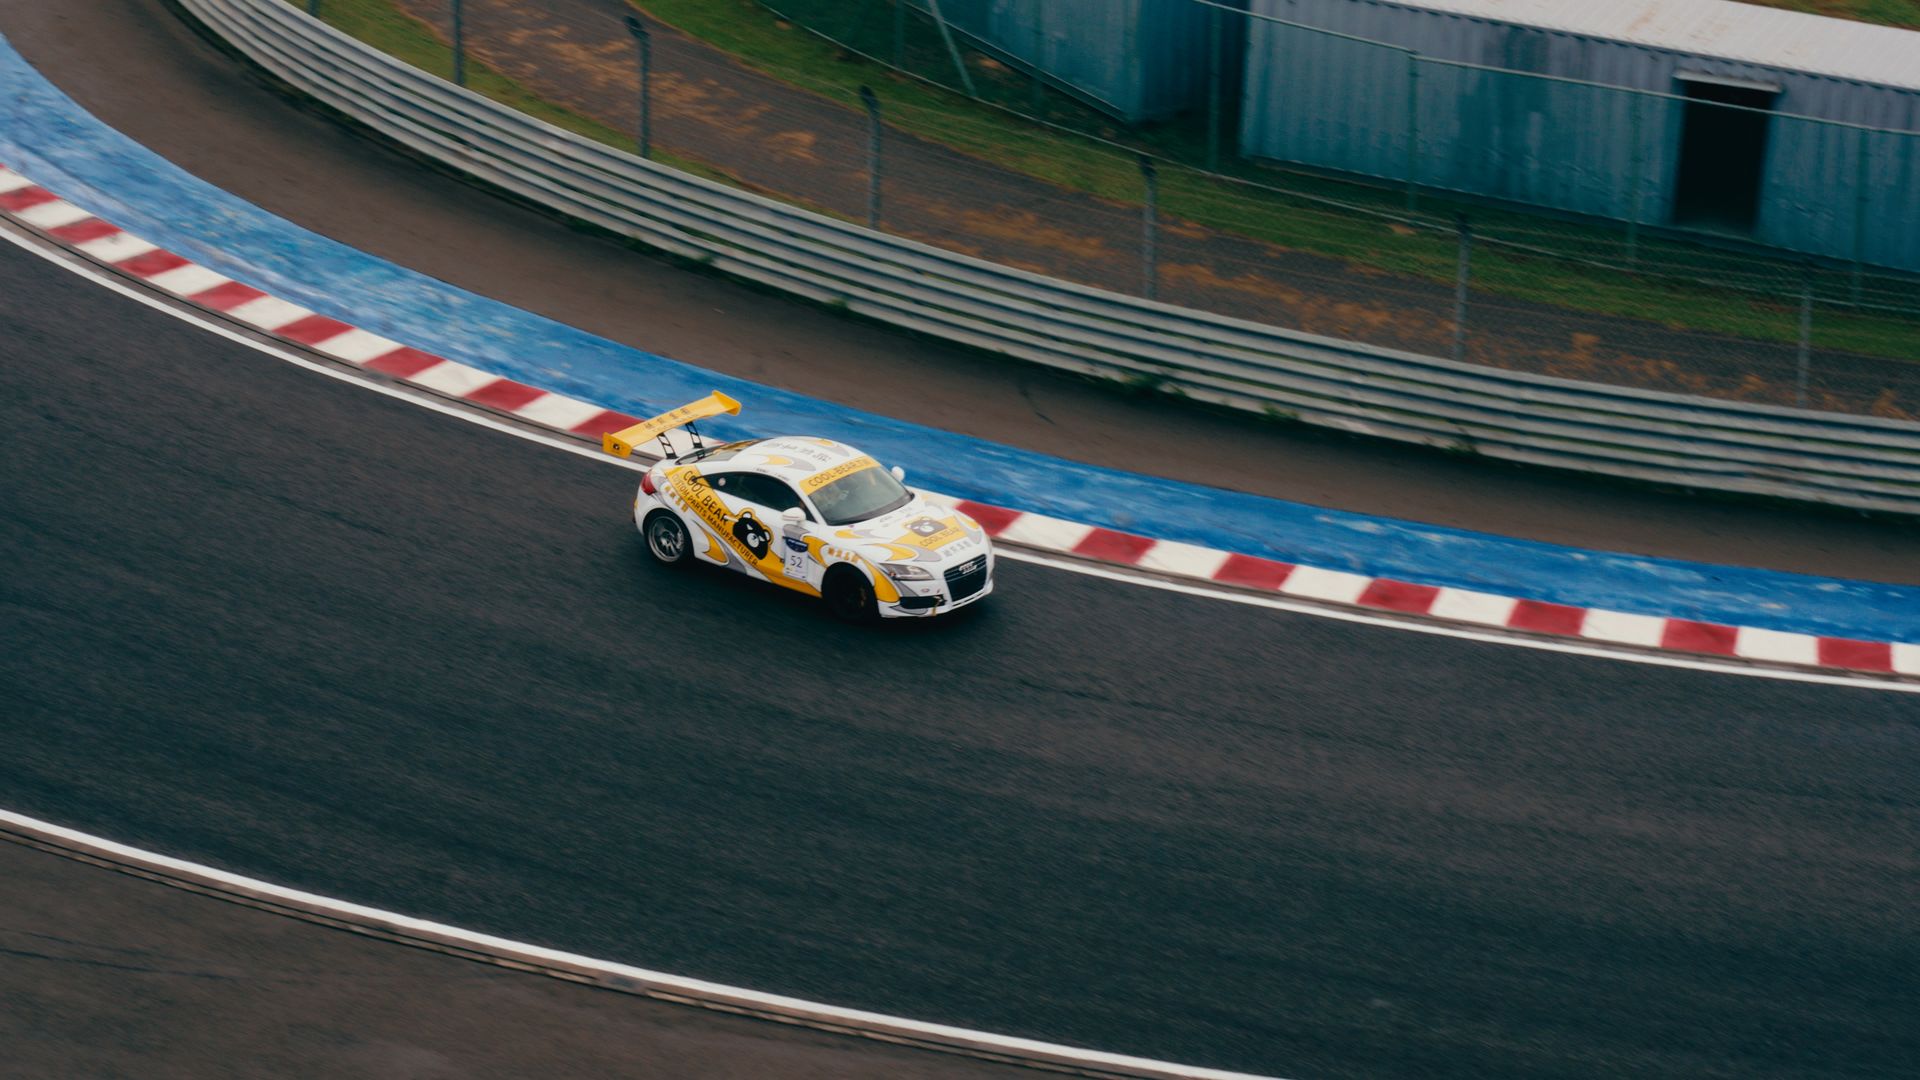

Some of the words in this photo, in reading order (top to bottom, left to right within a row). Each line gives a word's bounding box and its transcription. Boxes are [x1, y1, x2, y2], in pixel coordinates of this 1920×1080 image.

[683, 470, 706, 499] COOL
[701, 495, 730, 526] BEAR
[687, 495, 707, 518] PARTS
[706, 515, 759, 566] MANUFACTURER
[919, 534, 943, 547] COOL
[790, 555, 803, 569] 52
